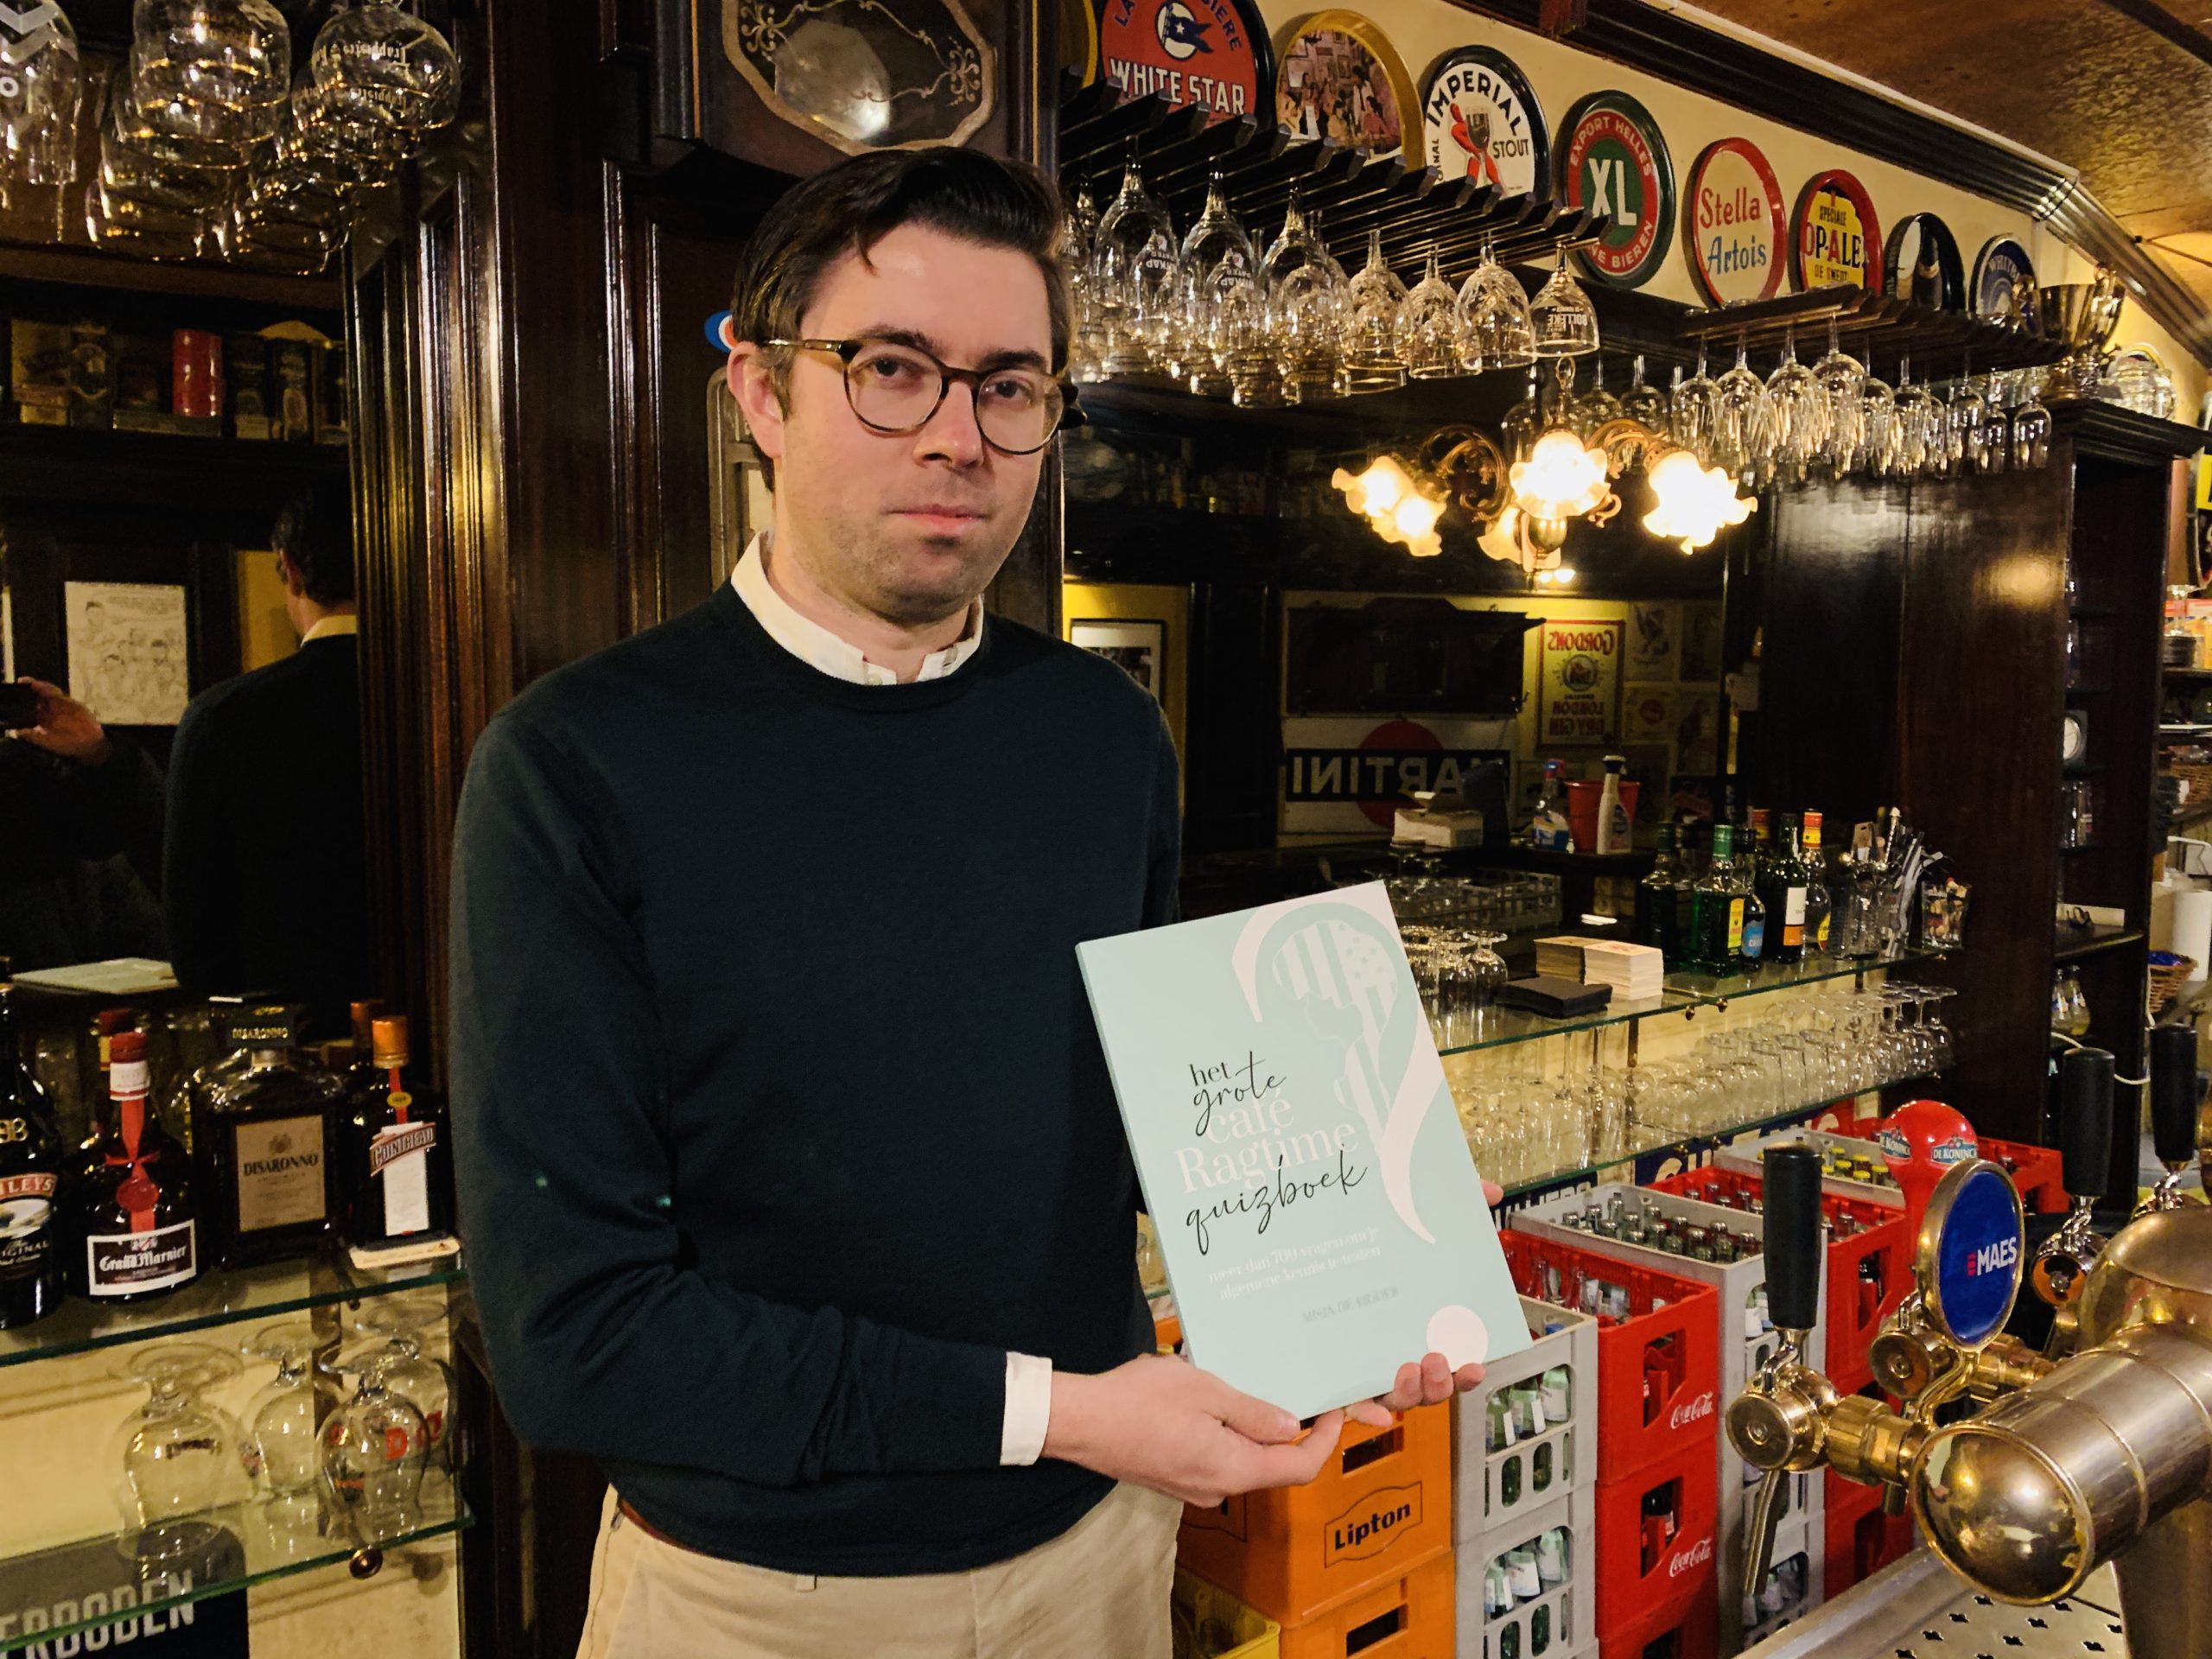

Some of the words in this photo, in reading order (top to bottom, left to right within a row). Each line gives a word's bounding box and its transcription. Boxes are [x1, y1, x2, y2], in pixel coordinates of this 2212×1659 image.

[1109, 58, 1183, 104] WHITE
[1188, 74, 1245, 116] STAR
[1427, 70, 1522, 137] IMPERIAL
[1492, 138, 1529, 159] STOUT
[1569, 116, 1611, 168] EXPORT
[1614, 119, 1653, 177] HELLES
[1588, 157, 1637, 227] XL
[1700, 187, 1761, 229] Stella
[1611, 219, 1654, 269] BIEREN
[1707, 234, 1767, 276] Artois
[232, 1027, 289, 1039] DISARONNO
[1190, 1061, 1231, 1086] het
[1193, 1051, 1287, 1137] grote
[1205, 1087, 1295, 1145] café
[243, 1153, 319, 1177] DISARONNO
[1173, 1121, 1359, 1195] Ragtime
[1185, 1142, 1368, 1256] quizboek
[1245, 1258, 1272, 1275] dan
[1976, 1236, 2018, 1276] MAES
[1334, 1503, 1411, 1551] Lipton
